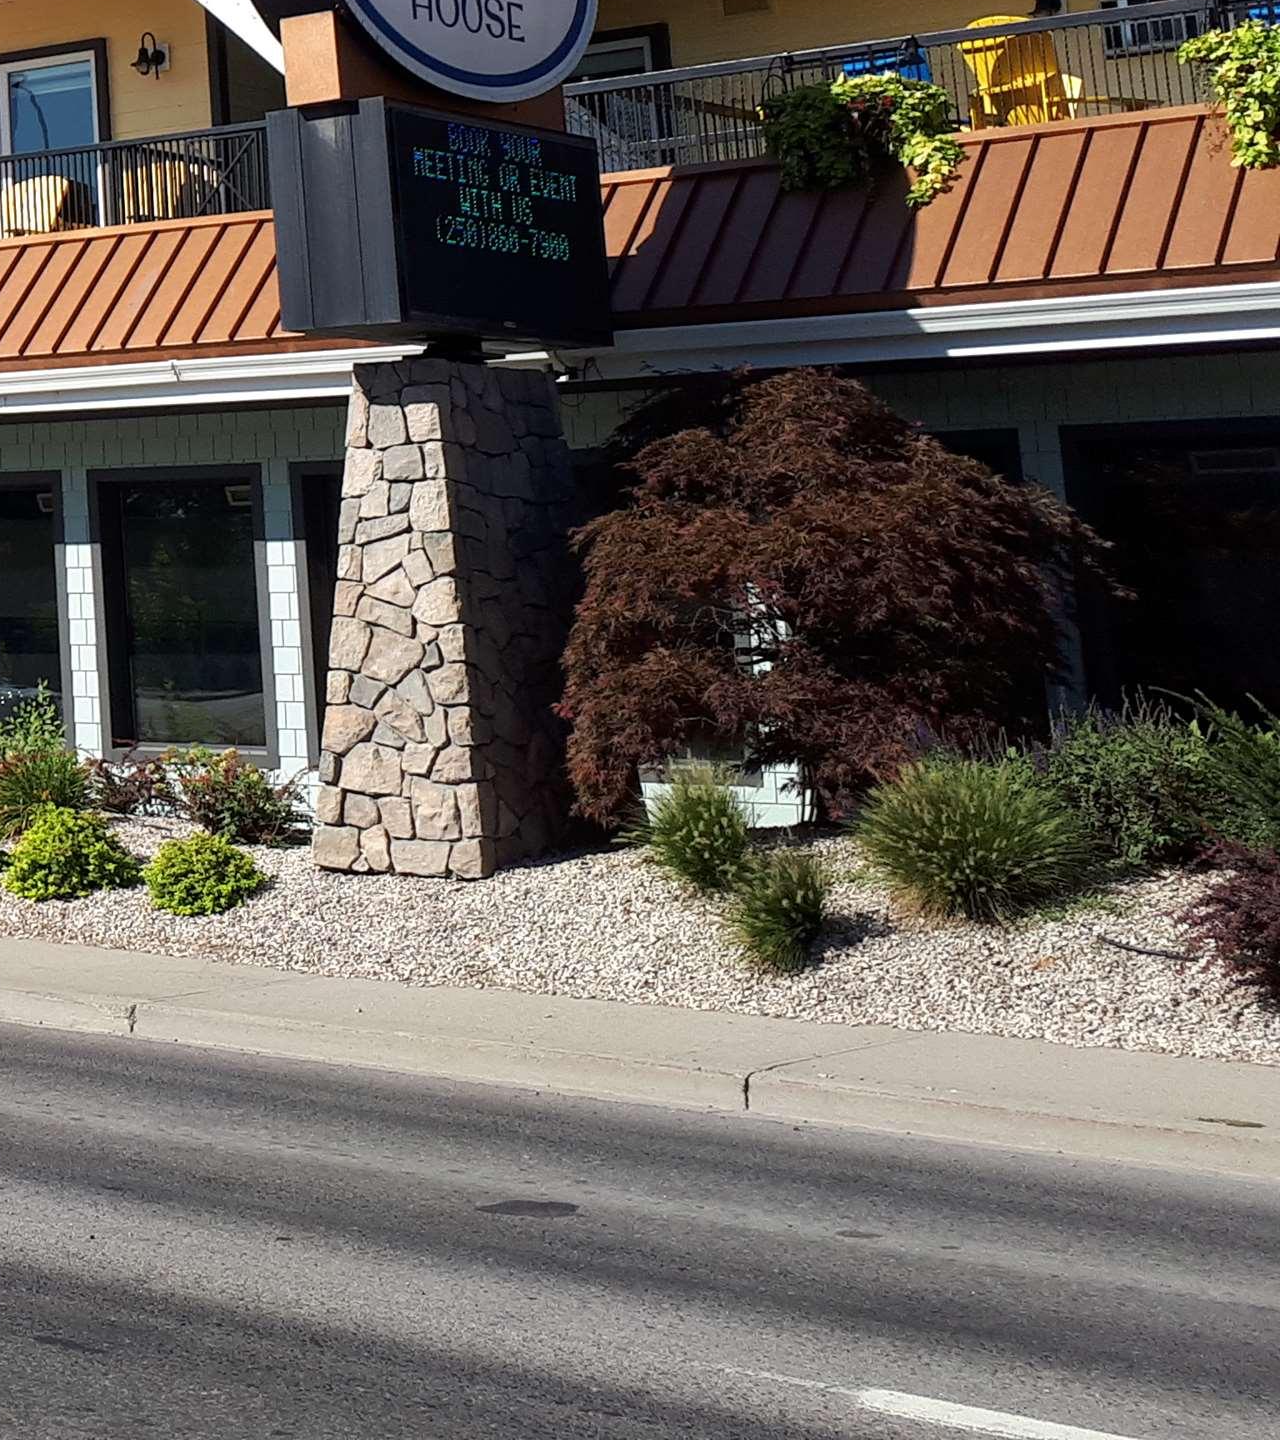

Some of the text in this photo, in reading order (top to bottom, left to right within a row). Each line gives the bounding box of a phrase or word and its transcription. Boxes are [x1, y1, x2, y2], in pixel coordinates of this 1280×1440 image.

[499, 132, 542, 166] YOUR
[412, 146, 577, 202] MEETING OR EVENT
[459, 186, 534, 226] WITH US
